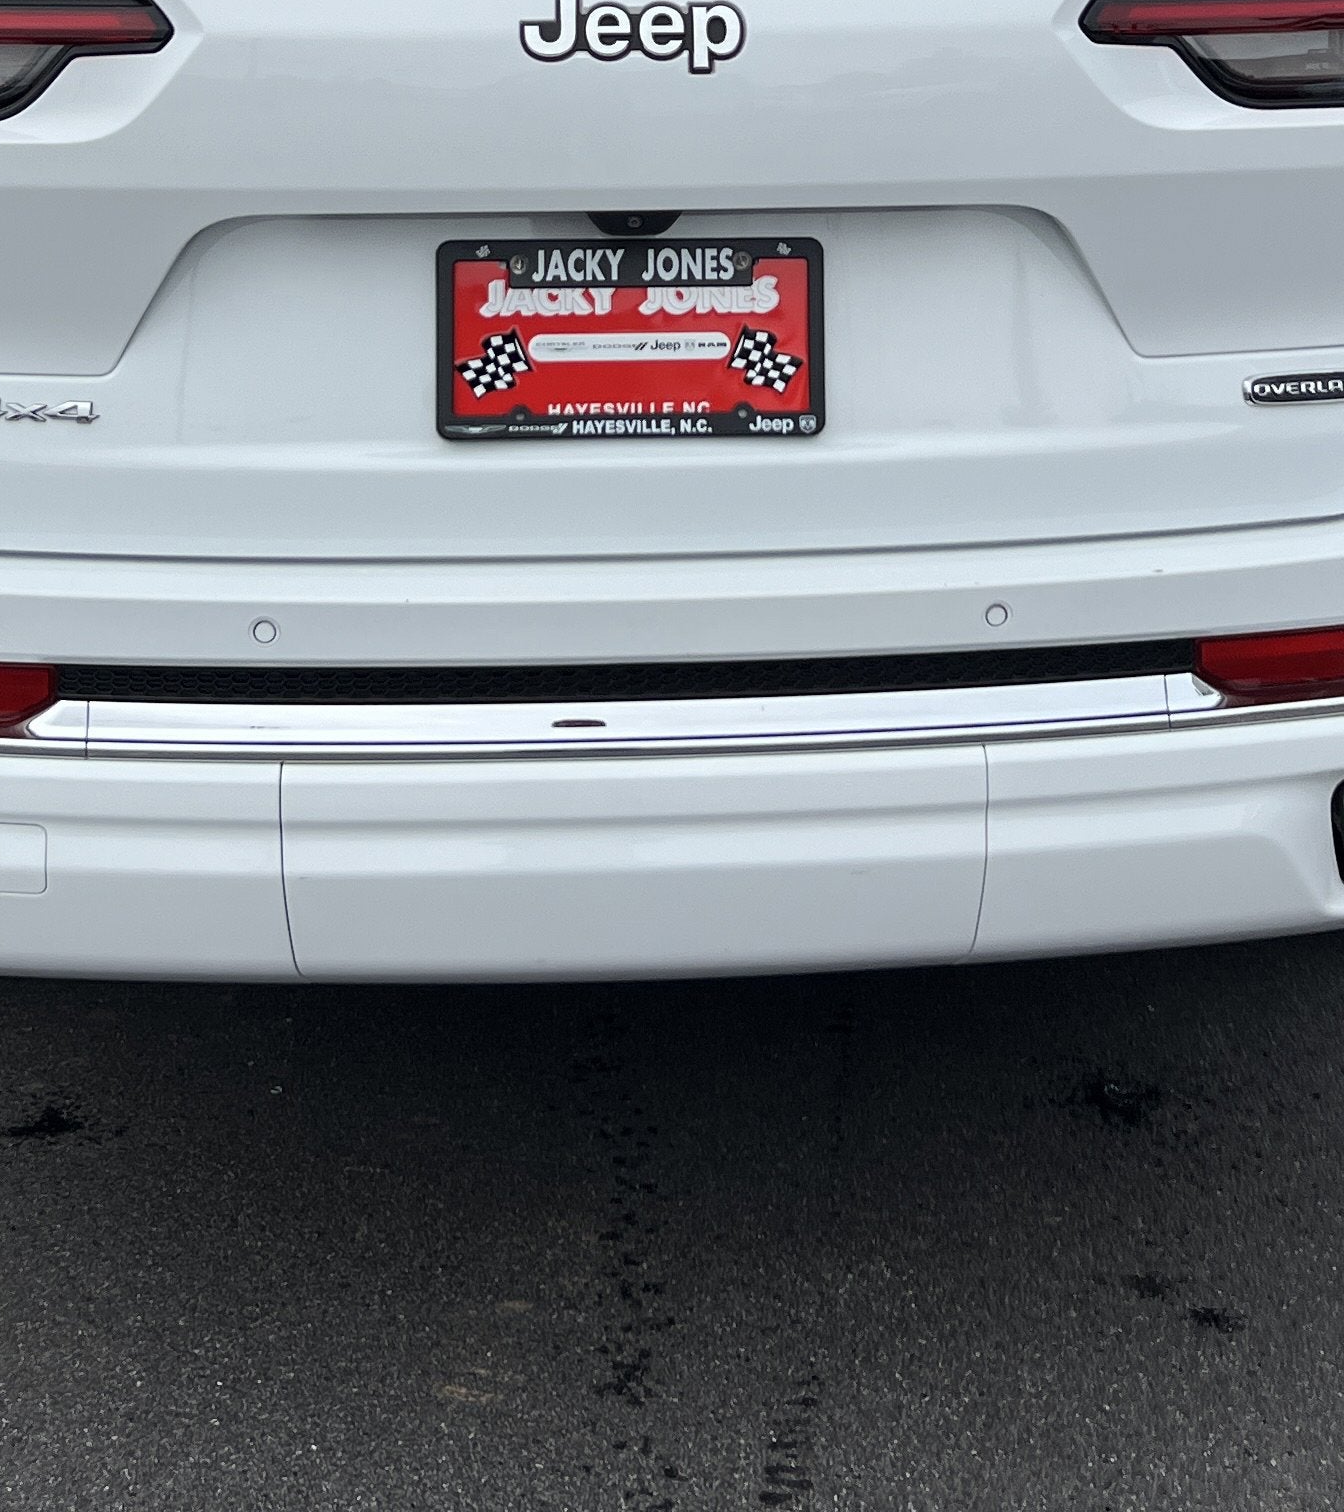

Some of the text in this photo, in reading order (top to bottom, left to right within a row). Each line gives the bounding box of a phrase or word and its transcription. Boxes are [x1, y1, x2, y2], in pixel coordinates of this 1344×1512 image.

[532, 247, 735, 283] JACKY JONES
[478, 274, 781, 317] JACKY JONES
[650, 339, 681, 352] Jeep
[572, 418, 676, 435] HAYESVILLE,
[680, 418, 713, 434] N.C.
[749, 415, 795, 434] Jeep
